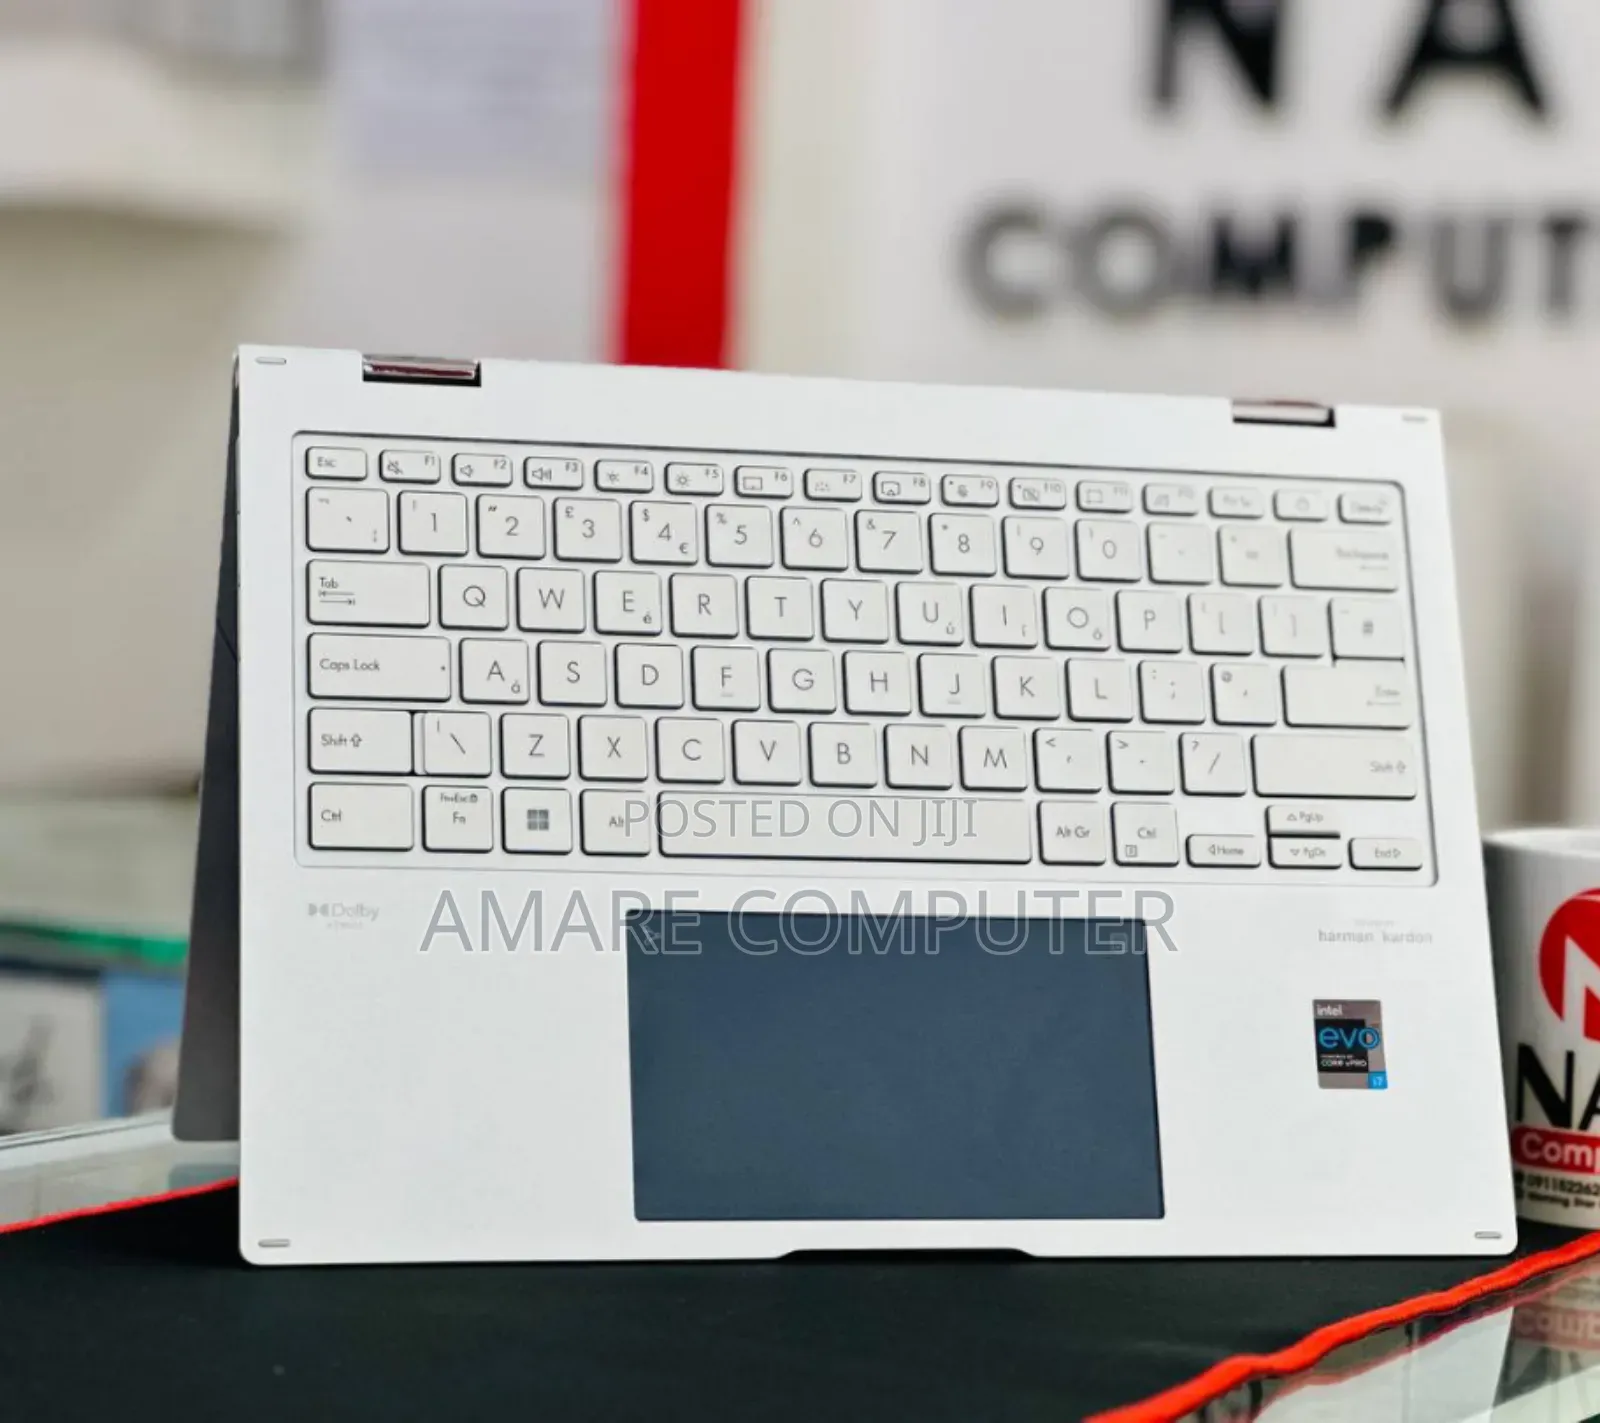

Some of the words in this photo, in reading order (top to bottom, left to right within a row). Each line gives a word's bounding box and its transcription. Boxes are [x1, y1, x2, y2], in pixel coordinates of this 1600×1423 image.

[317, 456, 337, 468] Esc
[424, 455, 436, 466] F1
[493, 458, 507, 469] F2
[564, 461, 578, 473] F3
[634, 465, 648, 476] F4
[704, 468, 719, 479] F5
[774, 471, 788, 482] F6
[912, 476, 926, 487] F8
[430, 512, 438, 533] 1
[505, 516, 520, 536] 2
[582, 519, 596, 539] 3
[658, 523, 673, 541] 4
[734, 525, 747, 545] 5
[809, 528, 823, 548] 6
[882, 530, 897, 550] 7
[958, 533, 970, 553] 8
[1029, 536, 1044, 556] 9
[319, 577, 339, 589] Tab
[463, 585, 487, 608] Q
[538, 588, 565, 610] W
[622, 591, 635, 612] E
[699, 593, 712, 615] R
[774, 596, 787, 617] T
[848, 600, 863, 621] Y
[922, 601, 938, 624] U
[1144, 609, 1158, 631] P
[319, 659, 350, 672] Caps
[353, 658, 380, 671] Lock
[486, 660, 505, 682] A
[566, 661, 581, 683] S
[641, 664, 660, 686] D
[721, 666, 732, 687] F
[792, 668, 815, 691] G
[870, 671, 888, 692] H
[949, 673, 960, 696] J
[1020, 676, 1034, 698] K
[1095, 677, 1108, 699] L
[320, 735, 348, 747] Shift
[529, 734, 545, 757] Z
[607, 736, 622, 758] X
[682, 738, 701, 761] C
[760, 739, 777, 762] V
[837, 743, 851, 765] B
[911, 745, 929, 767] N
[984, 747, 1008, 769] M
[320, 809, 342, 822] Ctrl
[452, 810, 466, 825] Fn
[1055, 826, 1071, 838] Alt
[1074, 826, 1090, 838] Gr
[1216, 845, 1244, 857] Home
[1374, 847, 1391, 859] End
[331, 902, 380, 923] Dolby
[1318, 928, 1374, 944] harman
[1381, 929, 1433, 945] kardon
[1316, 1004, 1343, 1017] intel
[1319, 1026, 1380, 1049] evo
[1372, 1076, 1383, 1087] i7
